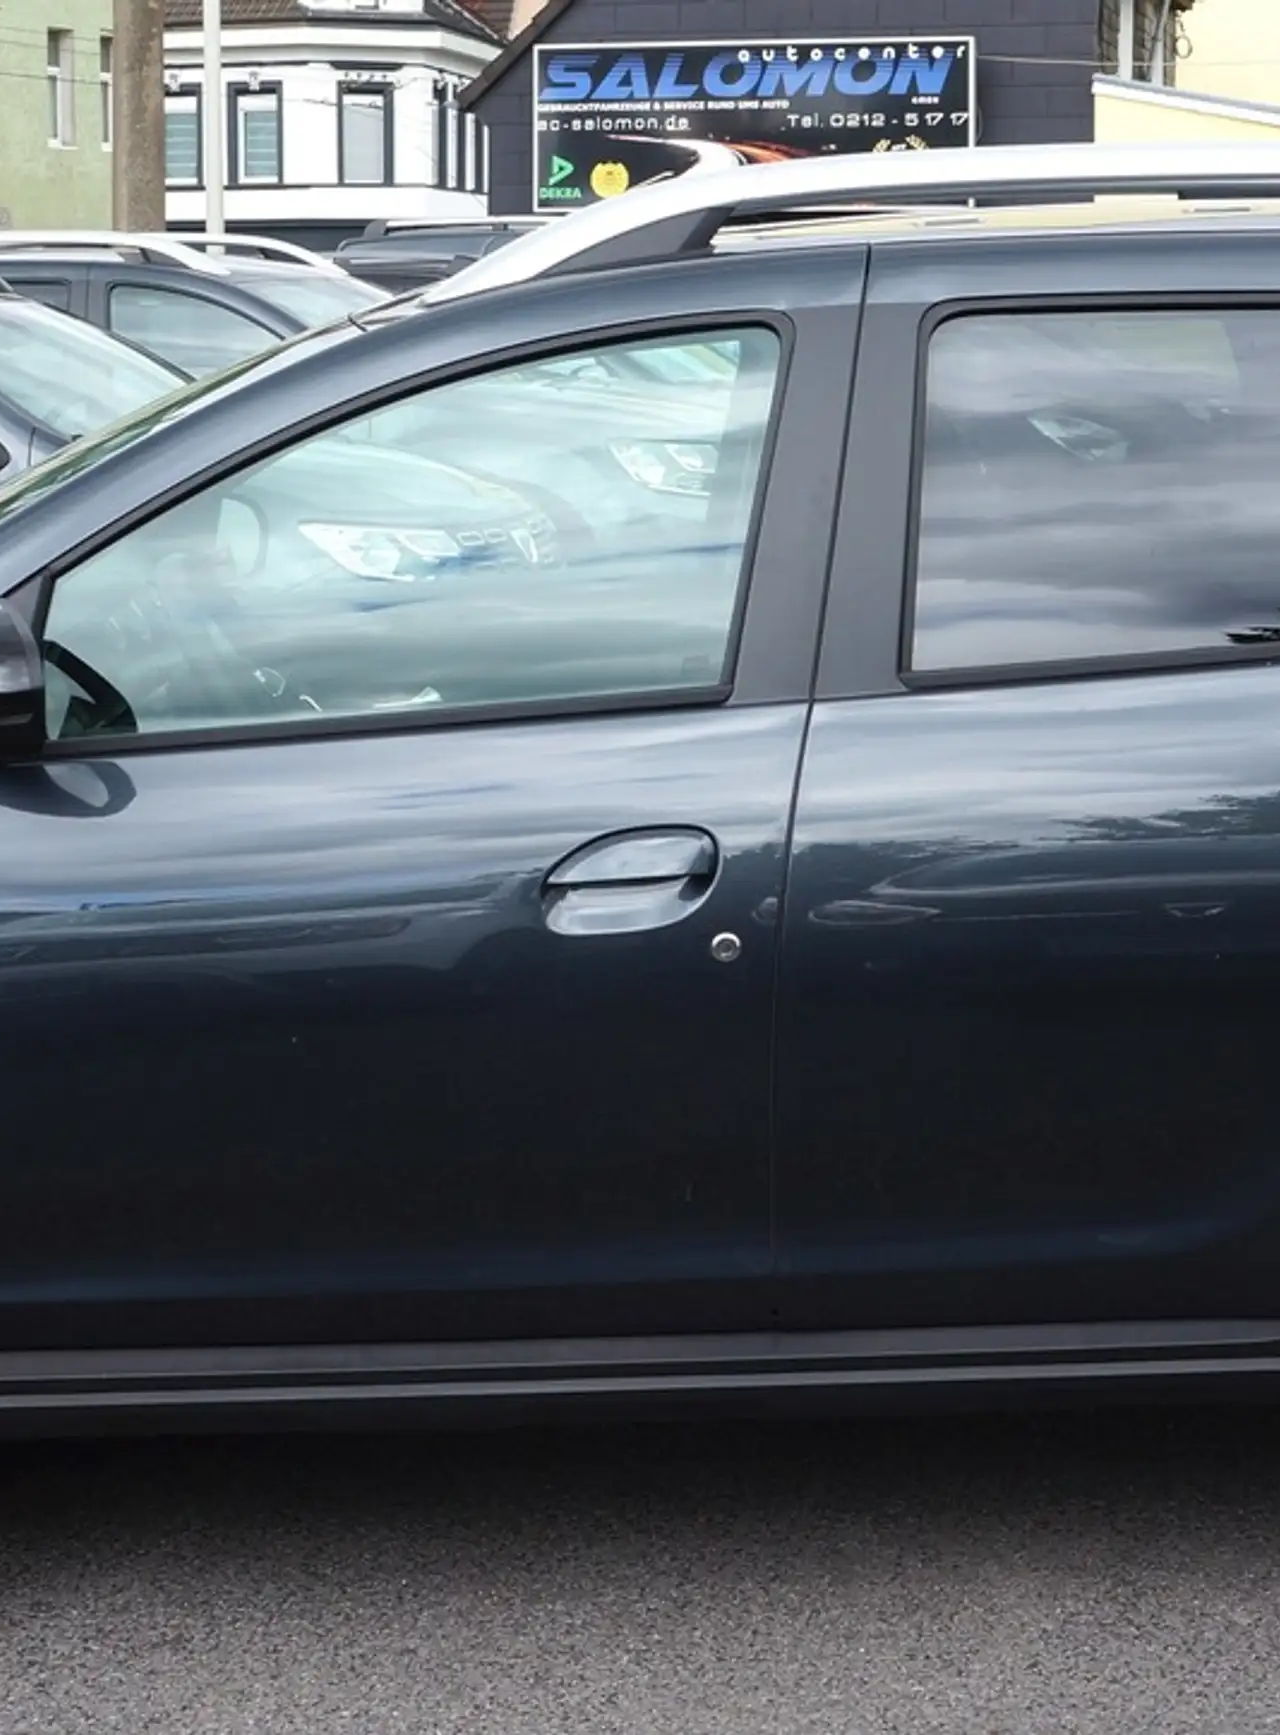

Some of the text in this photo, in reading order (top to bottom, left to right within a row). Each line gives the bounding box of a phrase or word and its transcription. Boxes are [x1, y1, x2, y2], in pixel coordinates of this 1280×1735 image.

[738, 43, 966, 63] autocenter
[539, 49, 956, 99] SALOMON
[664, 100, 704, 111] SERVICE
[786, 112, 824, 128] Tel.
[830, 112, 886, 127] 0212
[538, 187, 582, 200] DEKRA
